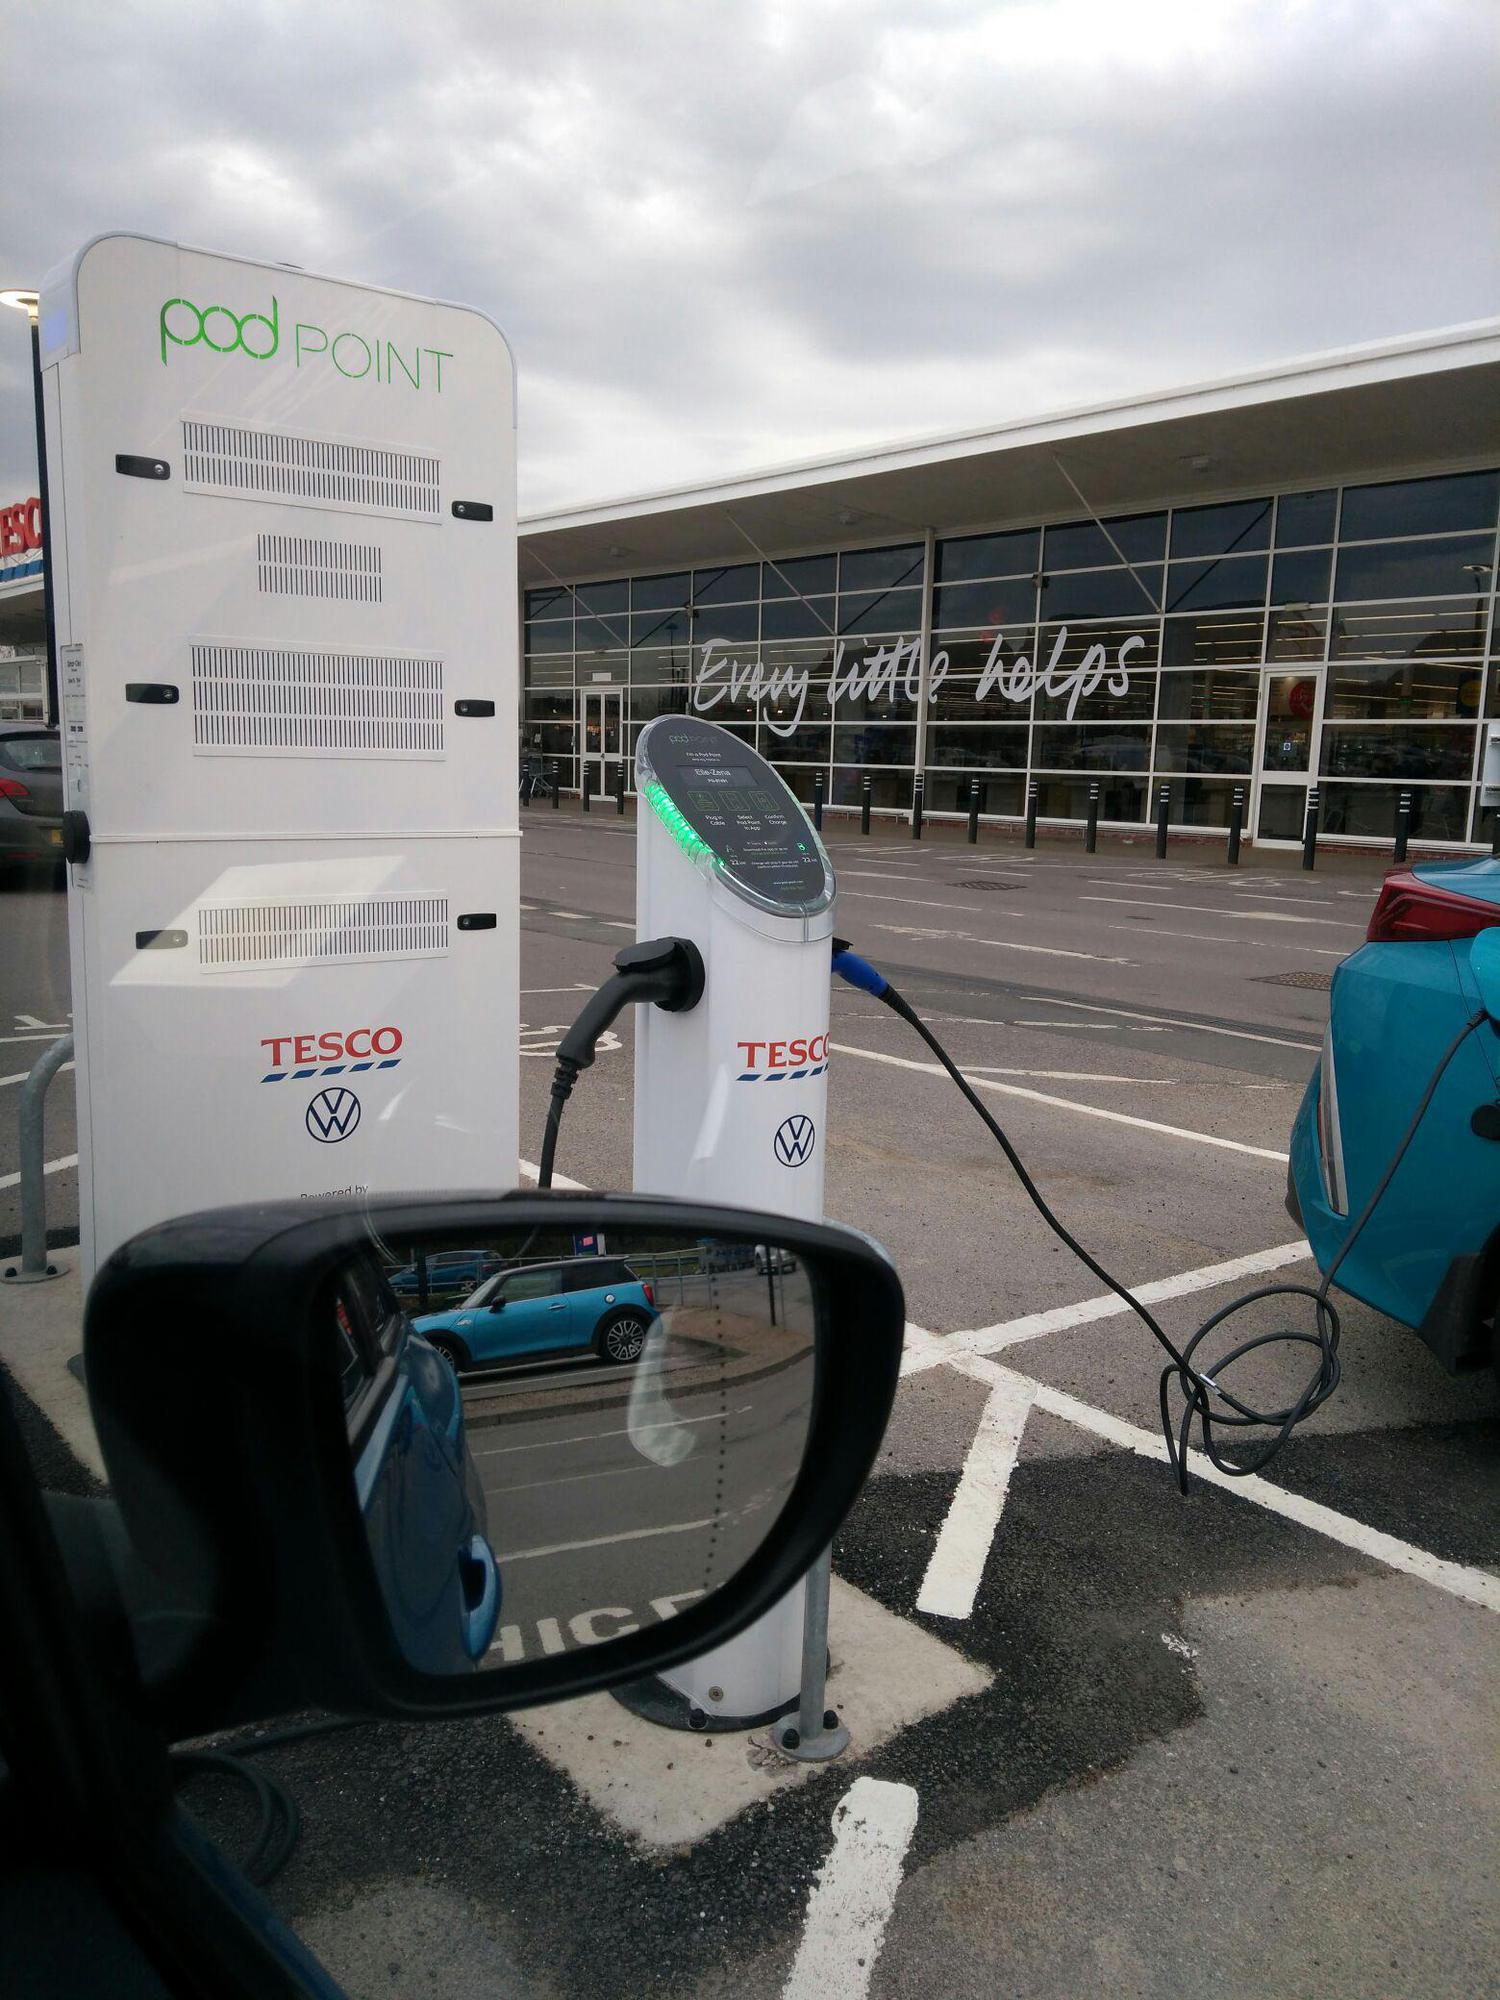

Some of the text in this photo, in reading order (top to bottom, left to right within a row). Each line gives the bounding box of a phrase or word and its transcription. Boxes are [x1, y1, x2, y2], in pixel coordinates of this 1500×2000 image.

[160, 294, 454, 393] pod POINT
[694, 626, 1145, 738] Every little helps
[261, 1027, 403, 1067] TESCO
